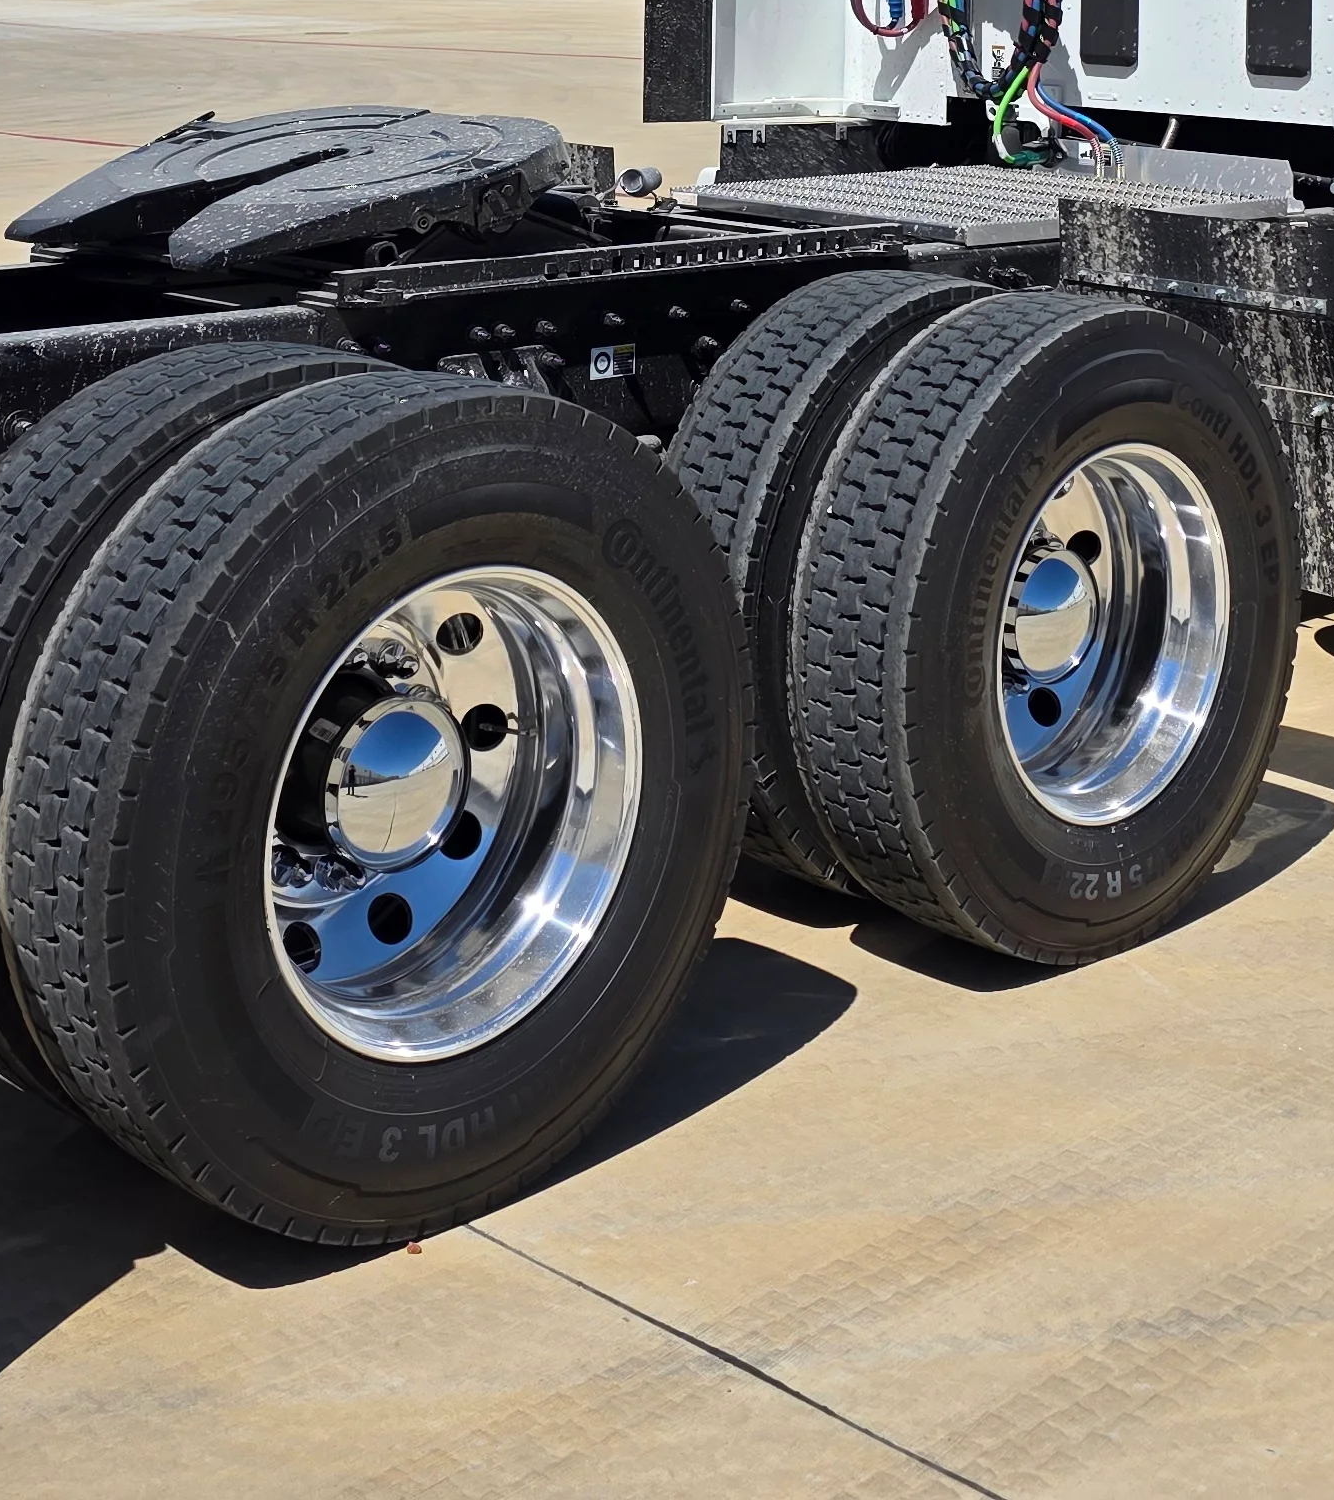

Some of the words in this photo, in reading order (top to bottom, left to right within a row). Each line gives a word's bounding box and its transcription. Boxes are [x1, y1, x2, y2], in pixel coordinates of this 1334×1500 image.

[1176, 383, 1232, 440] Conti
[1229, 432, 1262, 500] HDL
[1255, 504, 1272, 528] 3
[319, 521, 403, 611] 22.5
[964, 474, 1031, 708] Continental
[1260, 537, 1280, 586] EP
[602, 519, 715, 738] Continental
[377, 1125, 403, 1164] 3
